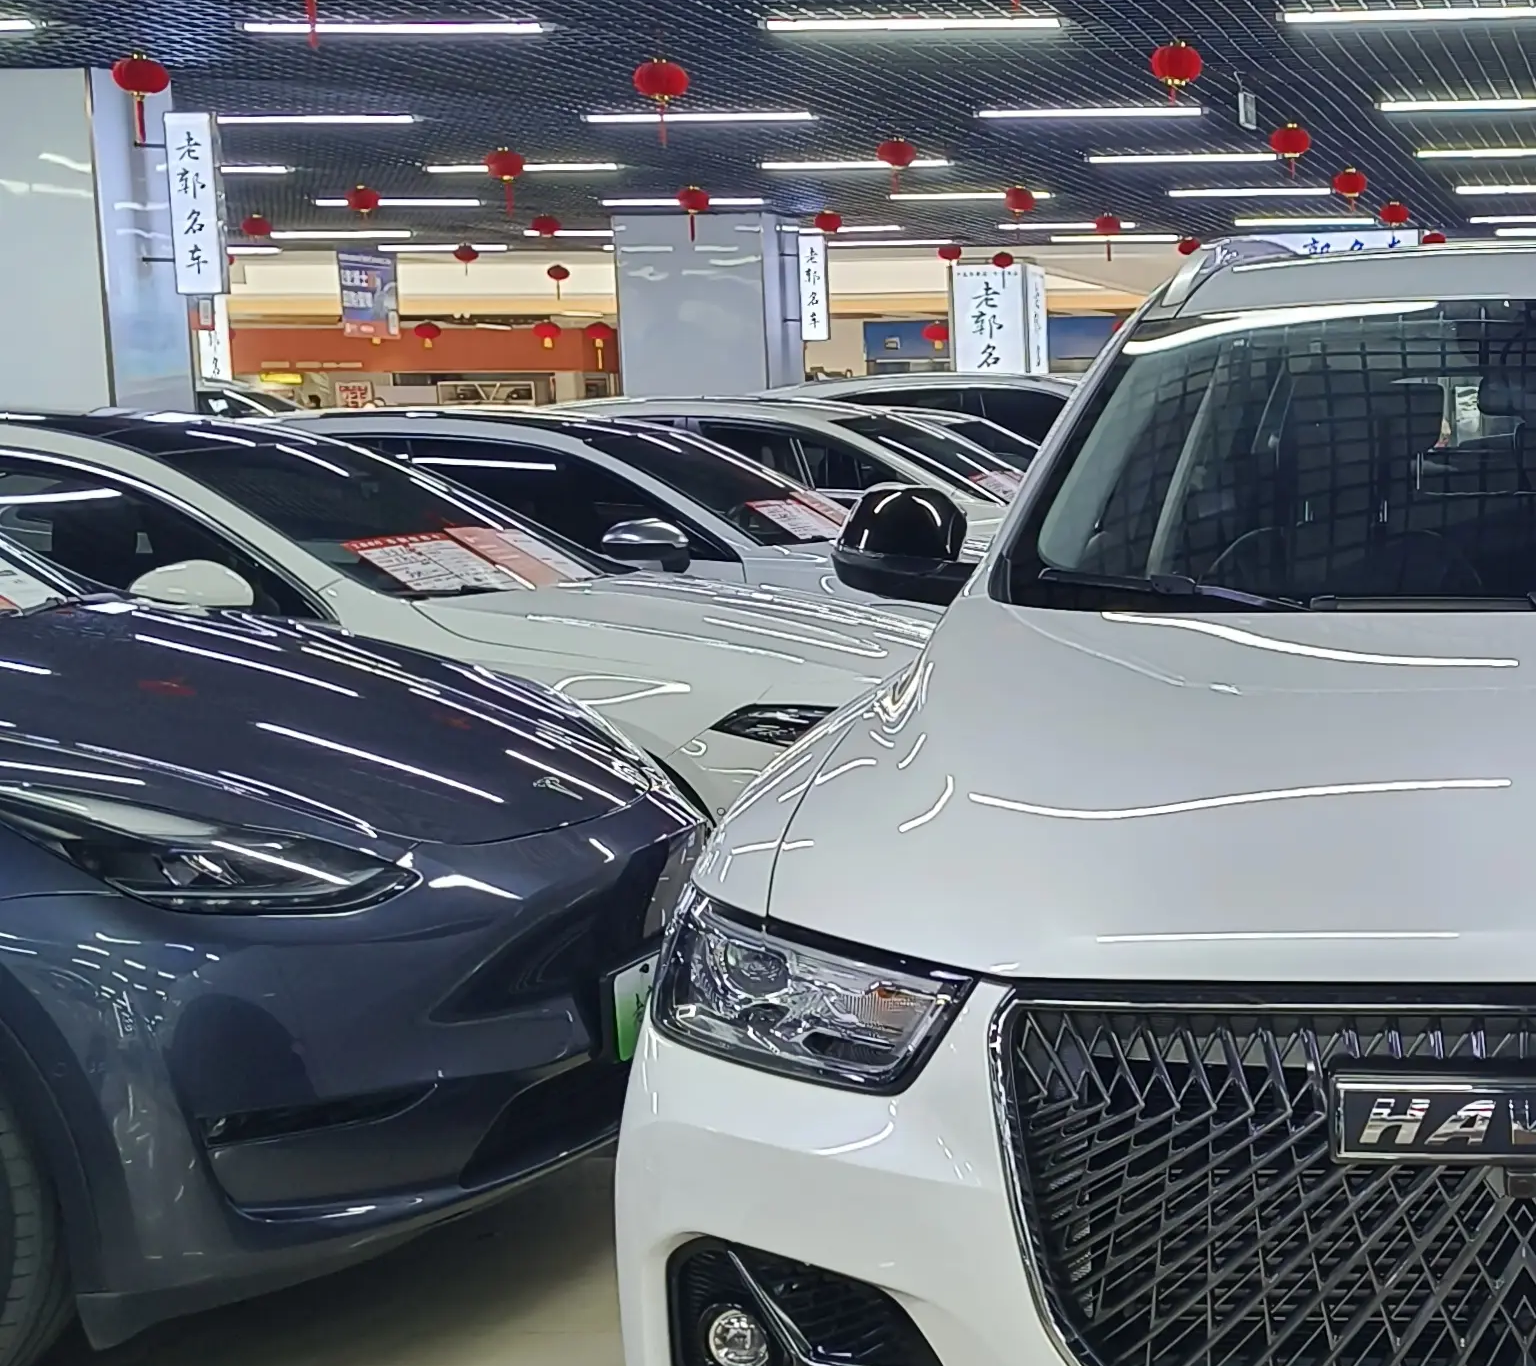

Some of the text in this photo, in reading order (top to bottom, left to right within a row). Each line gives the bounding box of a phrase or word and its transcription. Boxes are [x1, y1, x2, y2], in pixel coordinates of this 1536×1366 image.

[175, 131, 208, 275] 老郭名车
[971, 281, 1004, 369] 老郭名
